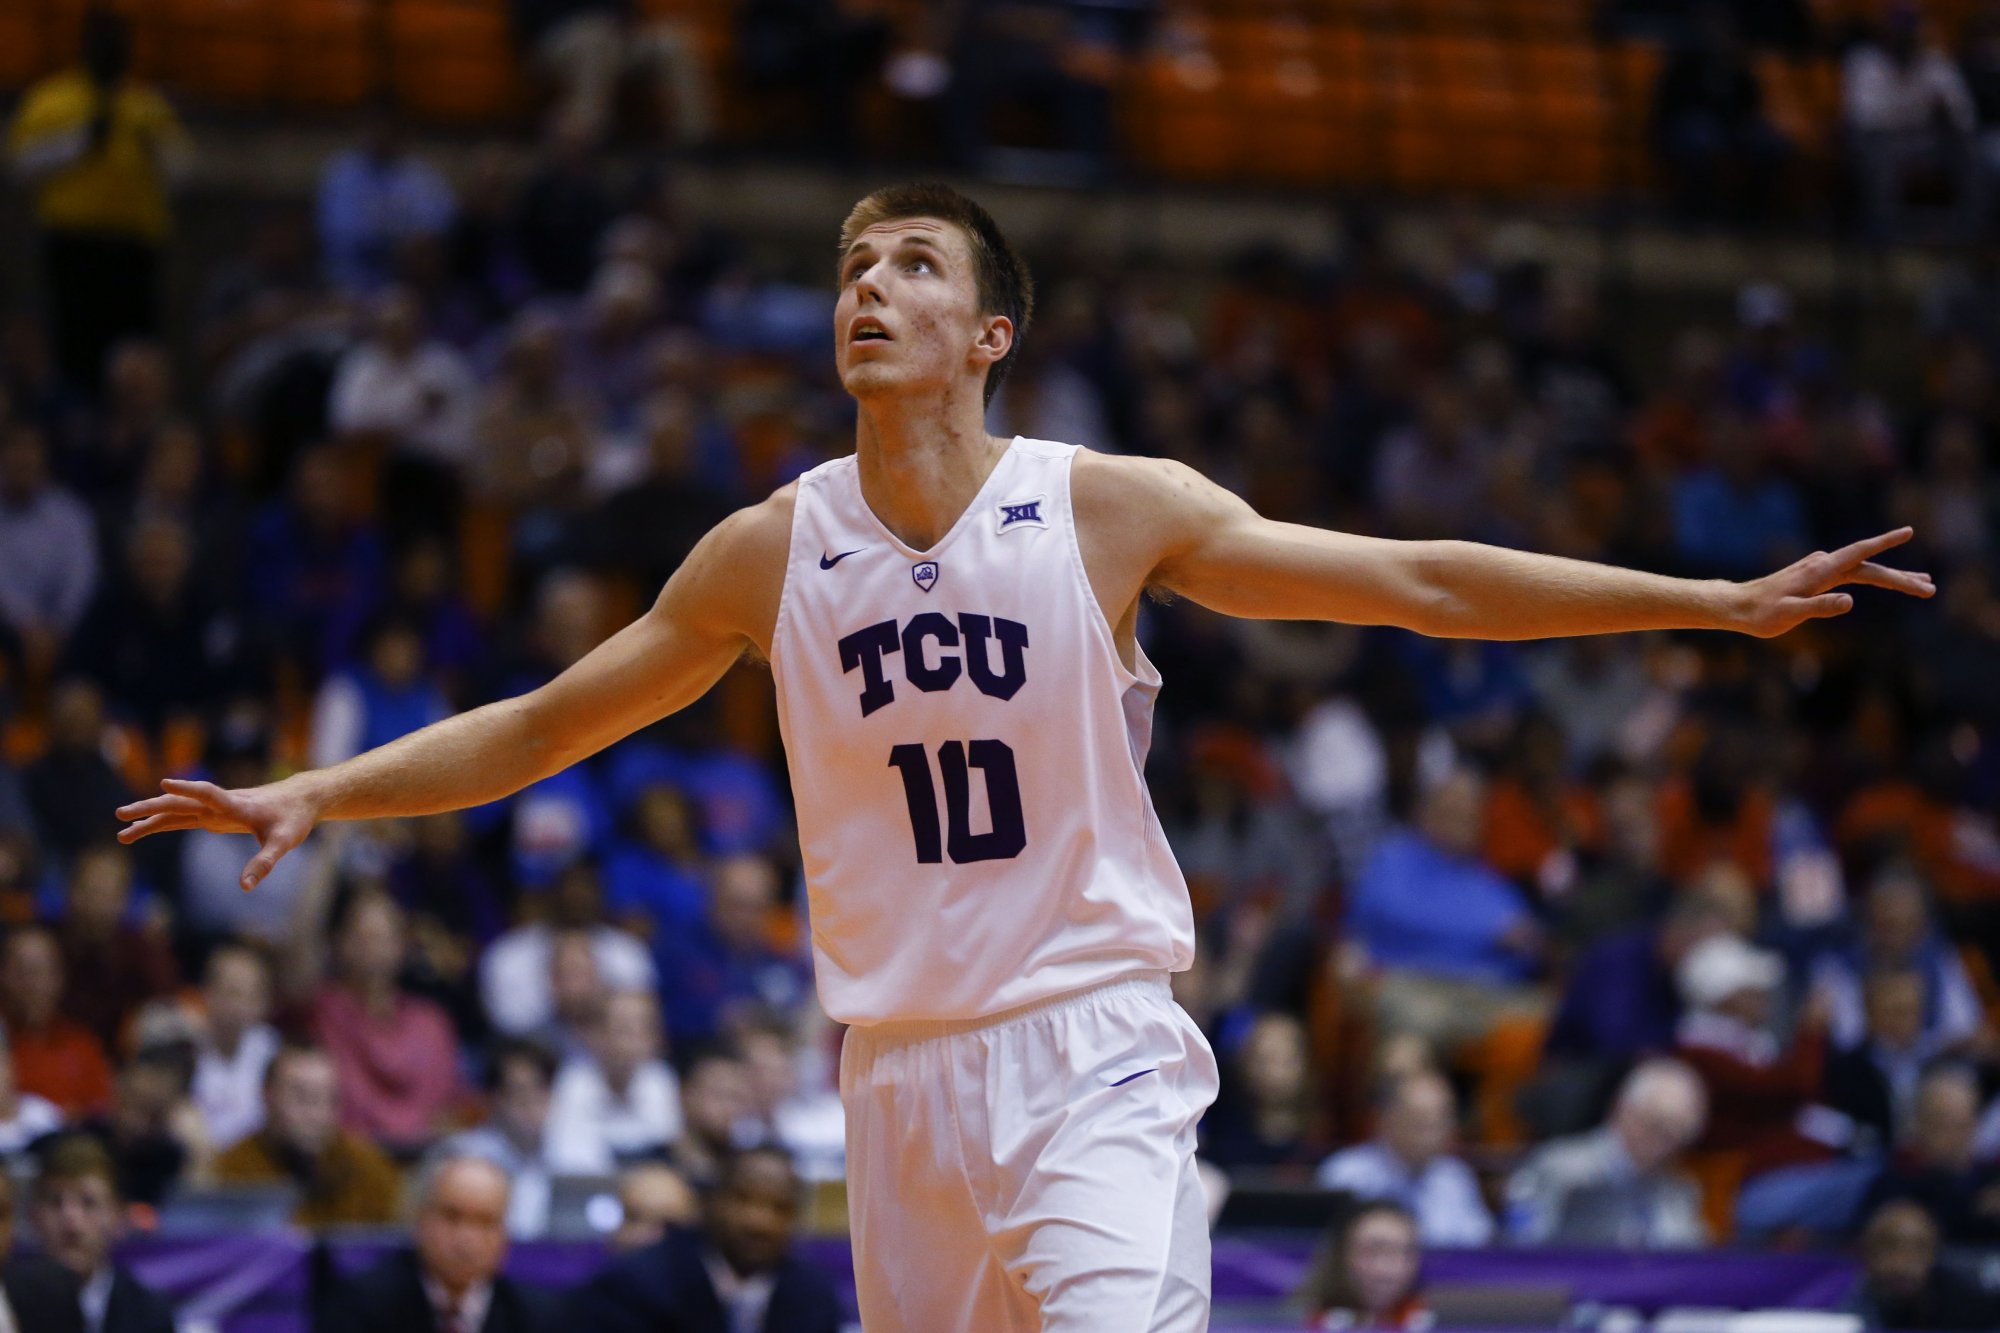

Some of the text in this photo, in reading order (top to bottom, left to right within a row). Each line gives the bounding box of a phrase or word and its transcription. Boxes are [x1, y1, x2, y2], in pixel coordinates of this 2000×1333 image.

[1001, 501, 1041, 525] XII
[837, 612, 1029, 718] TCU
[887, 738, 1027, 865] 10
